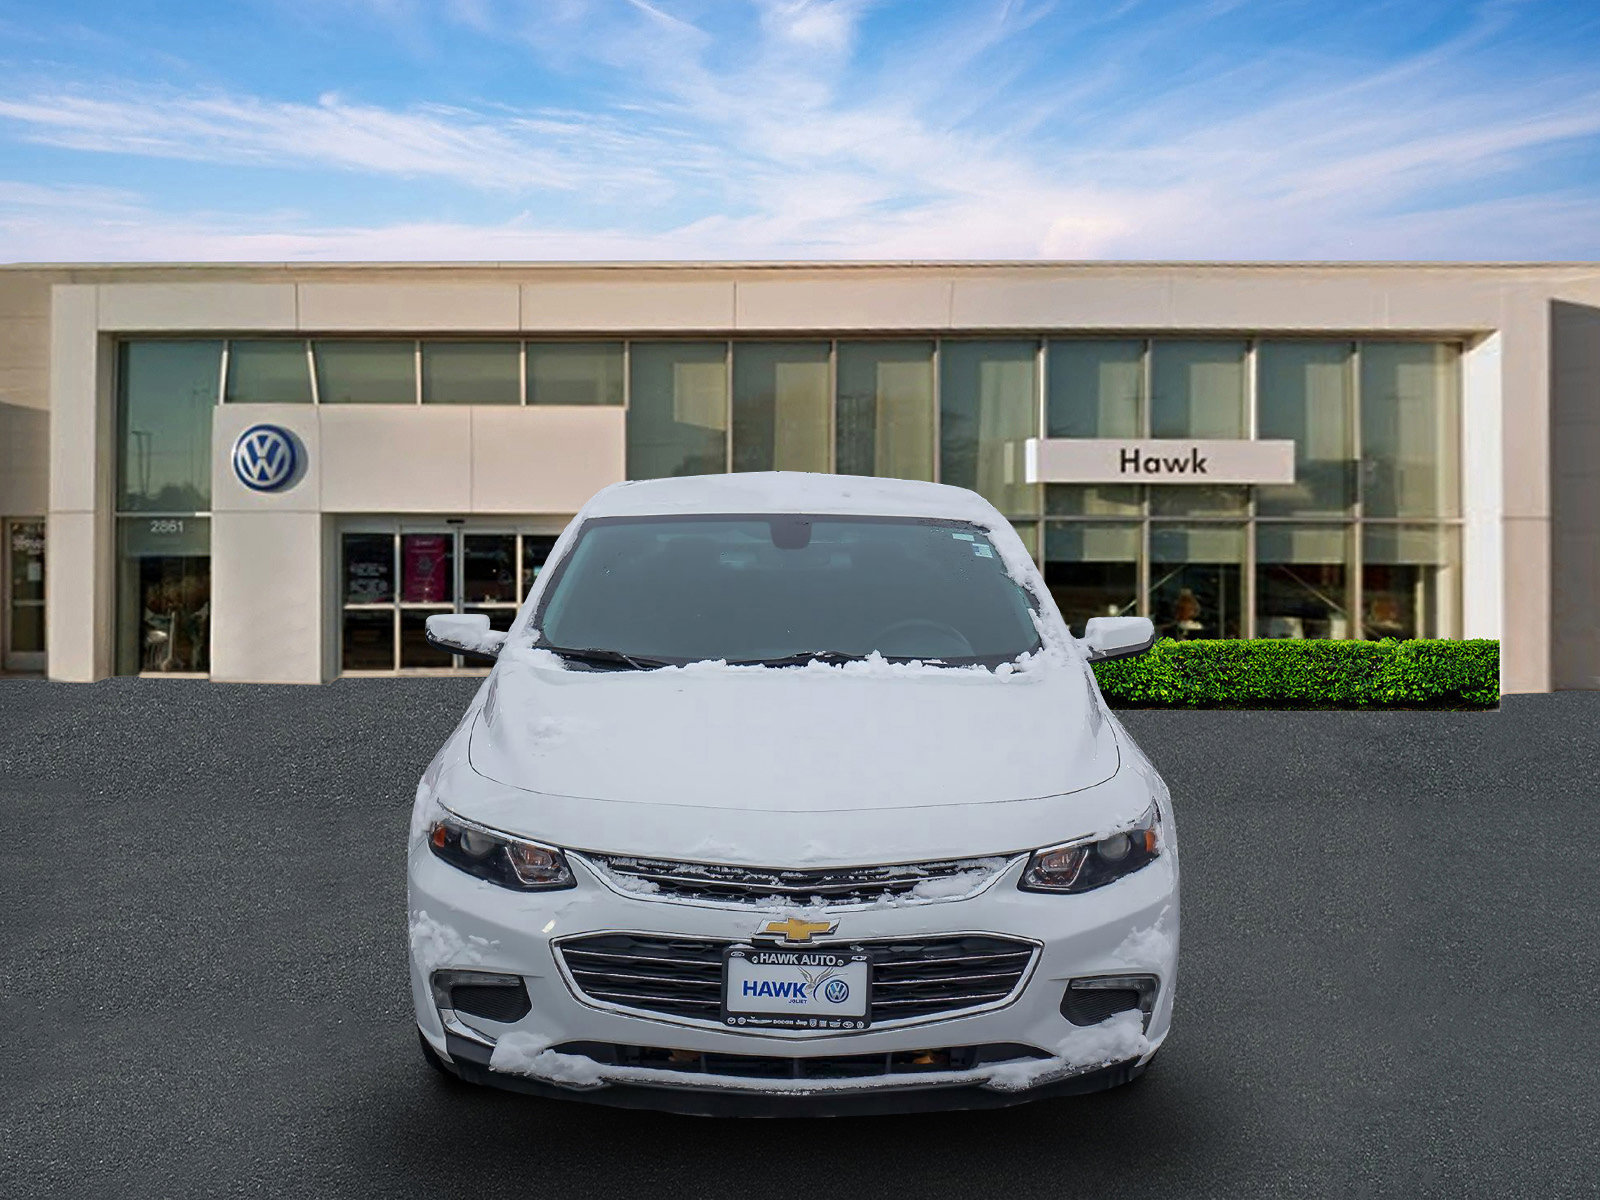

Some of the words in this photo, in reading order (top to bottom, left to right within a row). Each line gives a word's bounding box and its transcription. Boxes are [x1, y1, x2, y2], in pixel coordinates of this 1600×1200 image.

[1119, 448, 1207, 474] Hawk
[759, 953, 799, 965] HAWK
[800, 955, 836, 965] AUTO
[743, 980, 807, 998] HAWK
